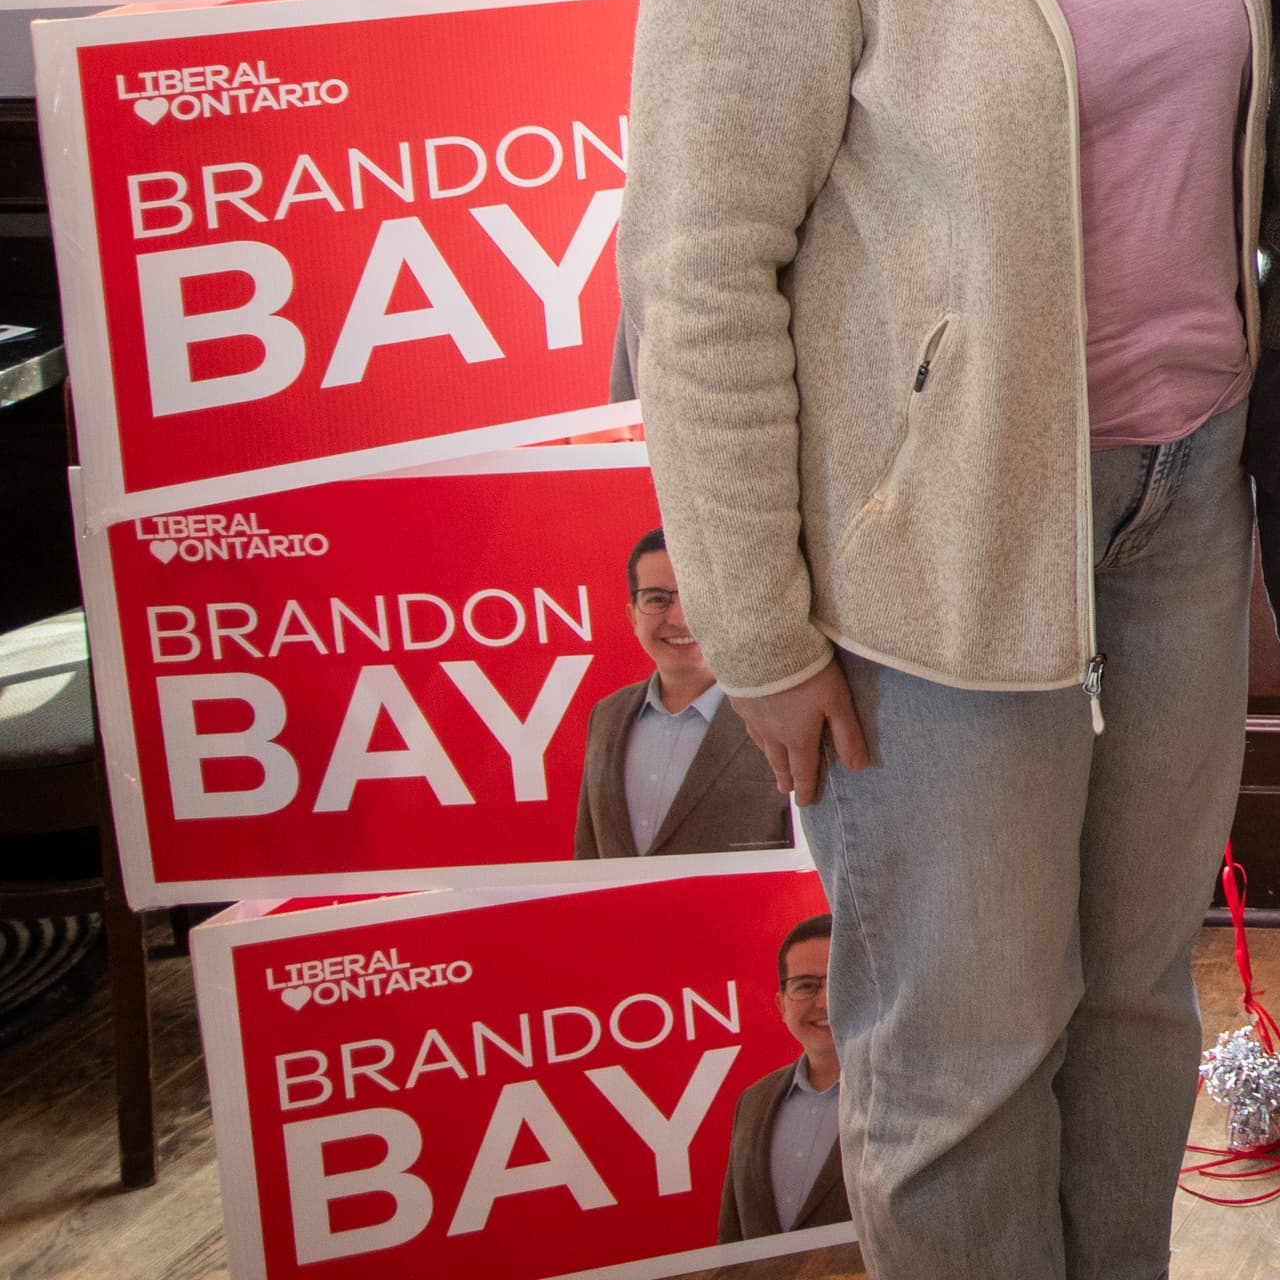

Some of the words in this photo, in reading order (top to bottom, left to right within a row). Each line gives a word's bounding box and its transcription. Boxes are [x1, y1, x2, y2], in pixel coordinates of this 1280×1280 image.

[116, 61, 280, 100] LIBERAL
[171, 79, 349, 120] ONTARIO
[127, 115, 629, 240] BRANDON
[136, 189, 624, 417] BAY
[135, 513, 270, 540] LIBERAL
[179, 533, 329, 562] ONTARIO
[146, 586, 593, 663] BRANDON
[155, 655, 594, 820] BAY
[265, 948, 411, 991] LIBERAL
[313, 960, 473, 1005] ONTARIO
[274, 980, 742, 1113] BRANDON
[283, 1045, 742, 1266] BAY
